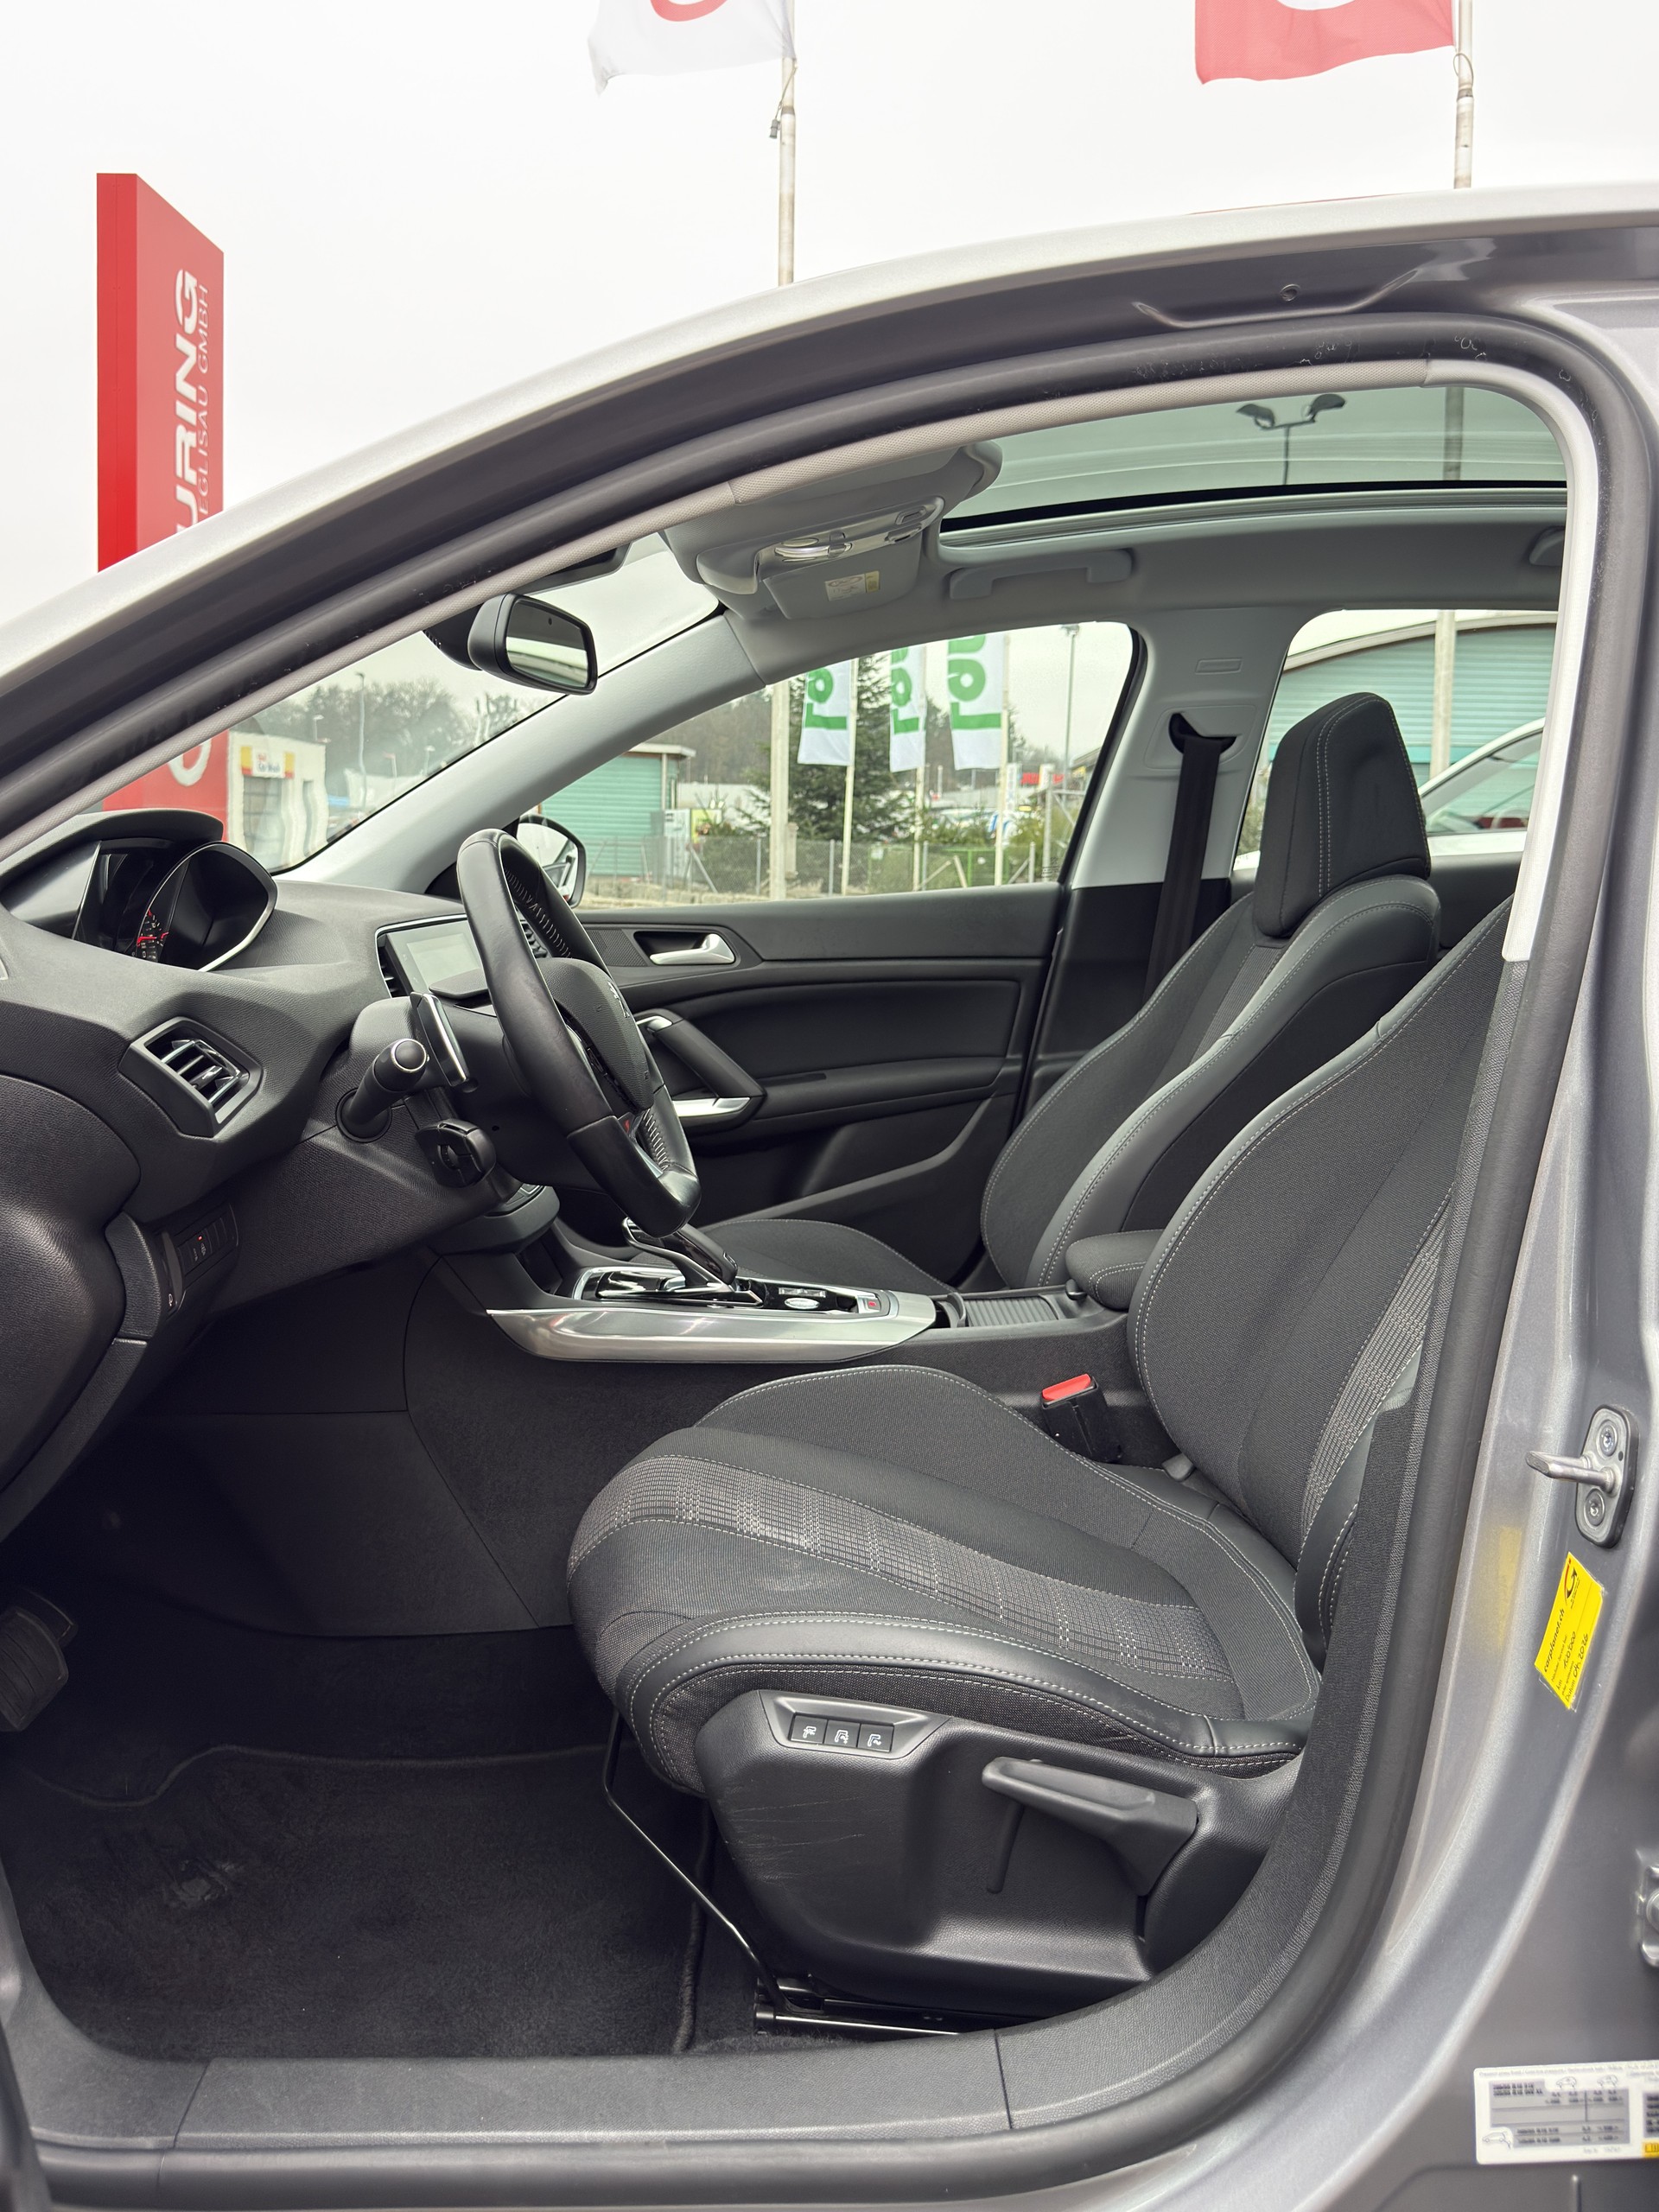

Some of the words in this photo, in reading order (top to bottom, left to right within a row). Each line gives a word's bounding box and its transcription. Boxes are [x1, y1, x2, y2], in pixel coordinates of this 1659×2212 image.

[197, 284, 208, 373] GMBH
[197, 385, 208, 515] EGLISAU
[1544, 1608, 1565, 1673] carplanet.ch
[1565, 1680, 1576, 1702] Datum
